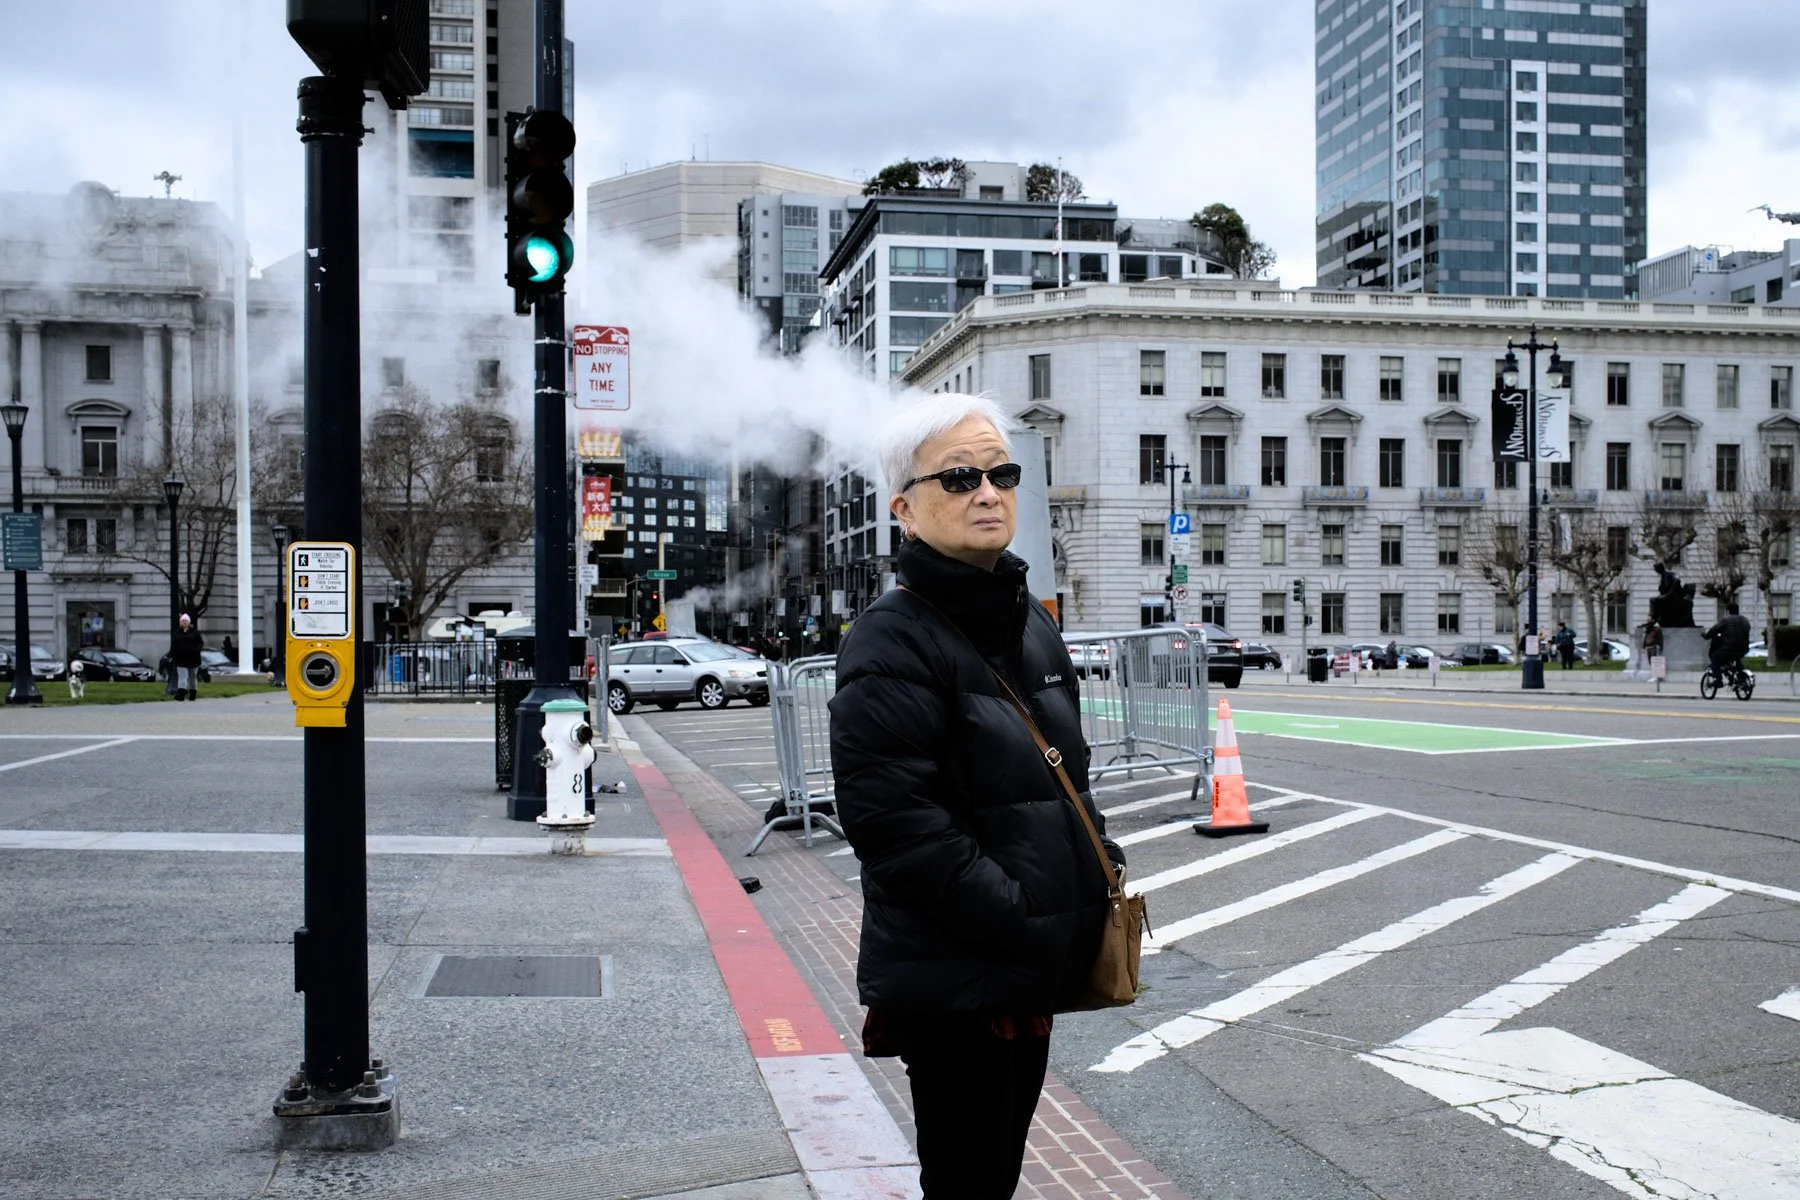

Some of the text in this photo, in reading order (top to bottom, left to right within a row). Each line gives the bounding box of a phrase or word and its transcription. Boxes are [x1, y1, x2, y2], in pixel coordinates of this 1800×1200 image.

[576, 345, 628, 356] NO STOPPING
[591, 362, 612, 374] ANY
[588, 380, 615, 392] TIME
[1173, 516, 1188, 533] P
[572, 773, 583, 794] 8
